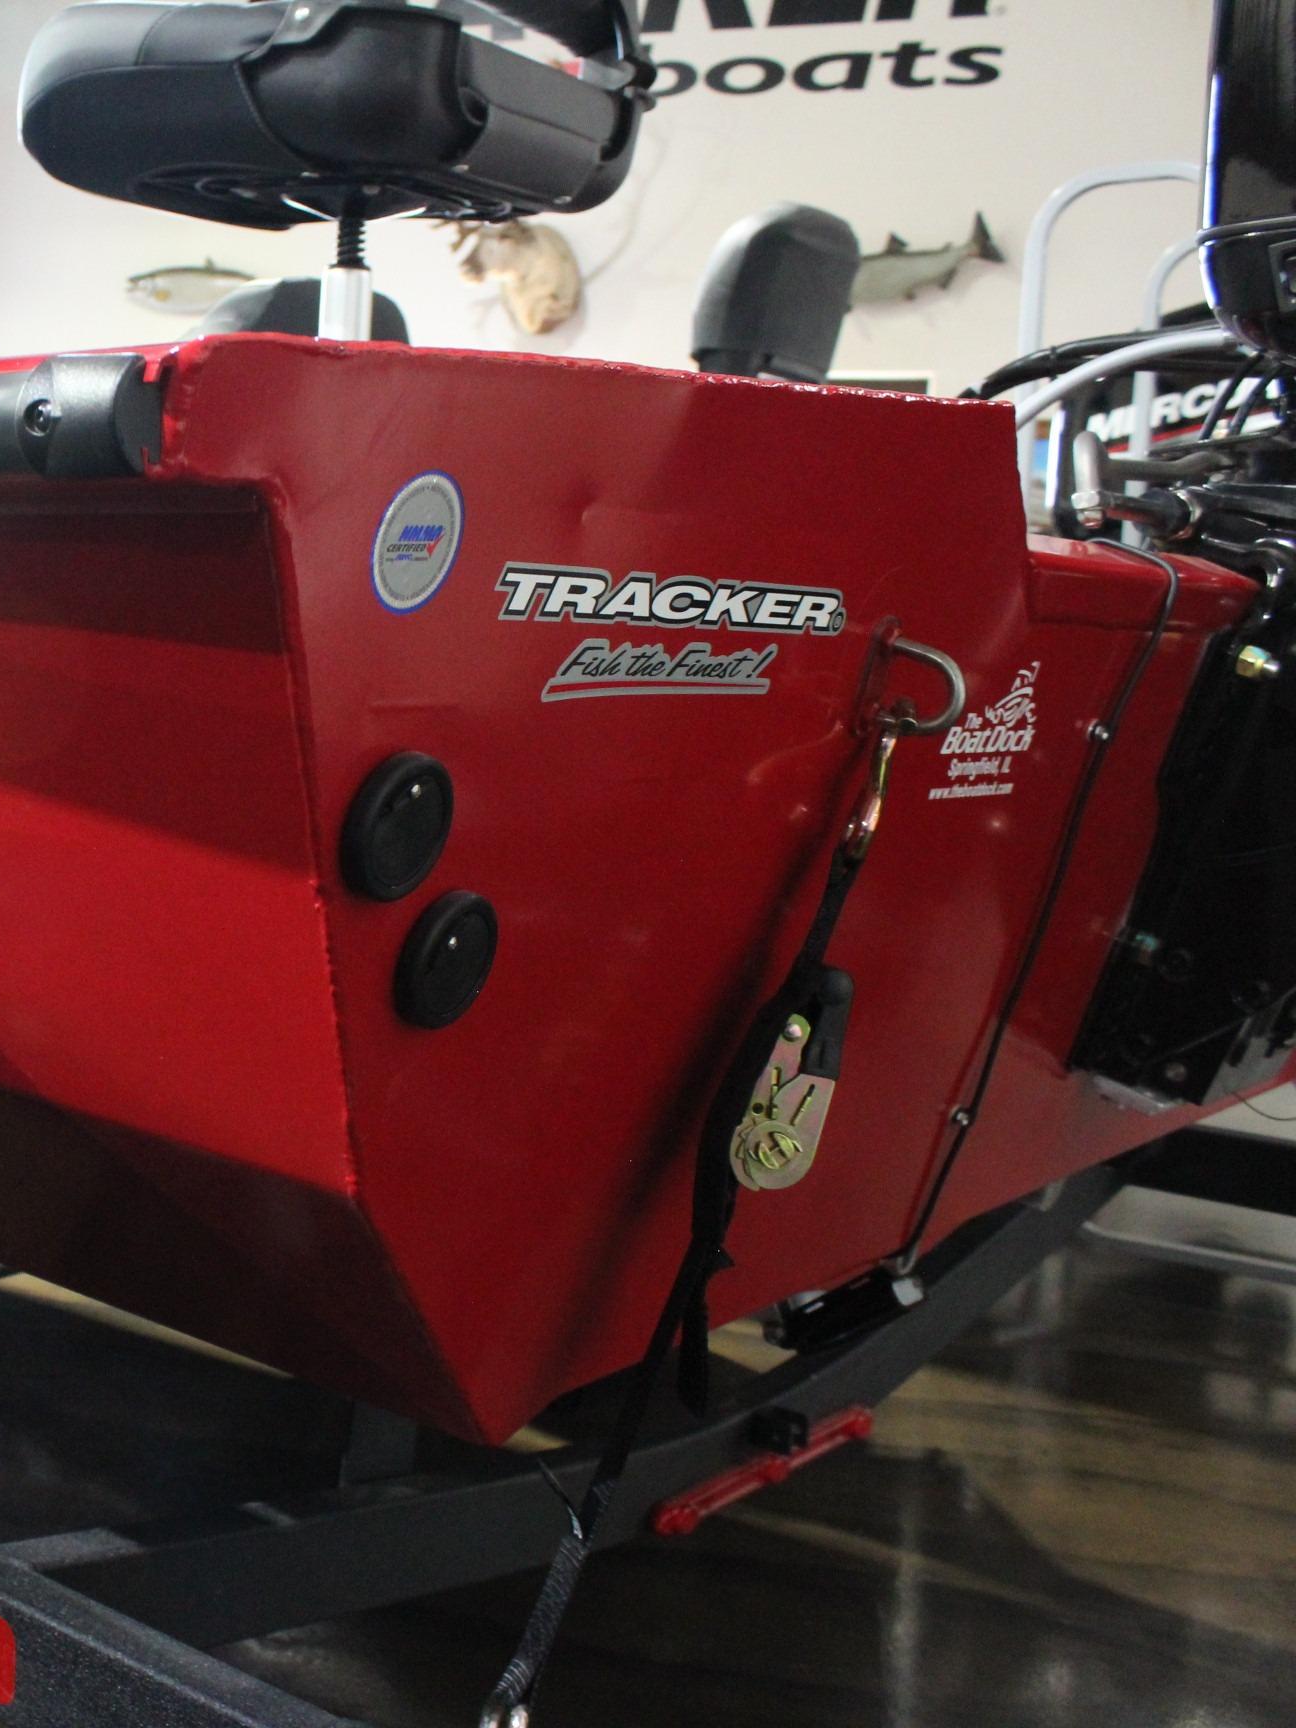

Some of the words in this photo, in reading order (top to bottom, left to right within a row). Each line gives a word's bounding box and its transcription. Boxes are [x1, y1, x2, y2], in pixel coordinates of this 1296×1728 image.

[642, 42, 1003, 97] boats
[386, 543, 426, 553] CERTIFIED
[500, 566, 842, 631] TRACKER
[561, 648, 622, 677] Fish
[625, 650, 666, 677] the
[964, 712, 983, 729] The
